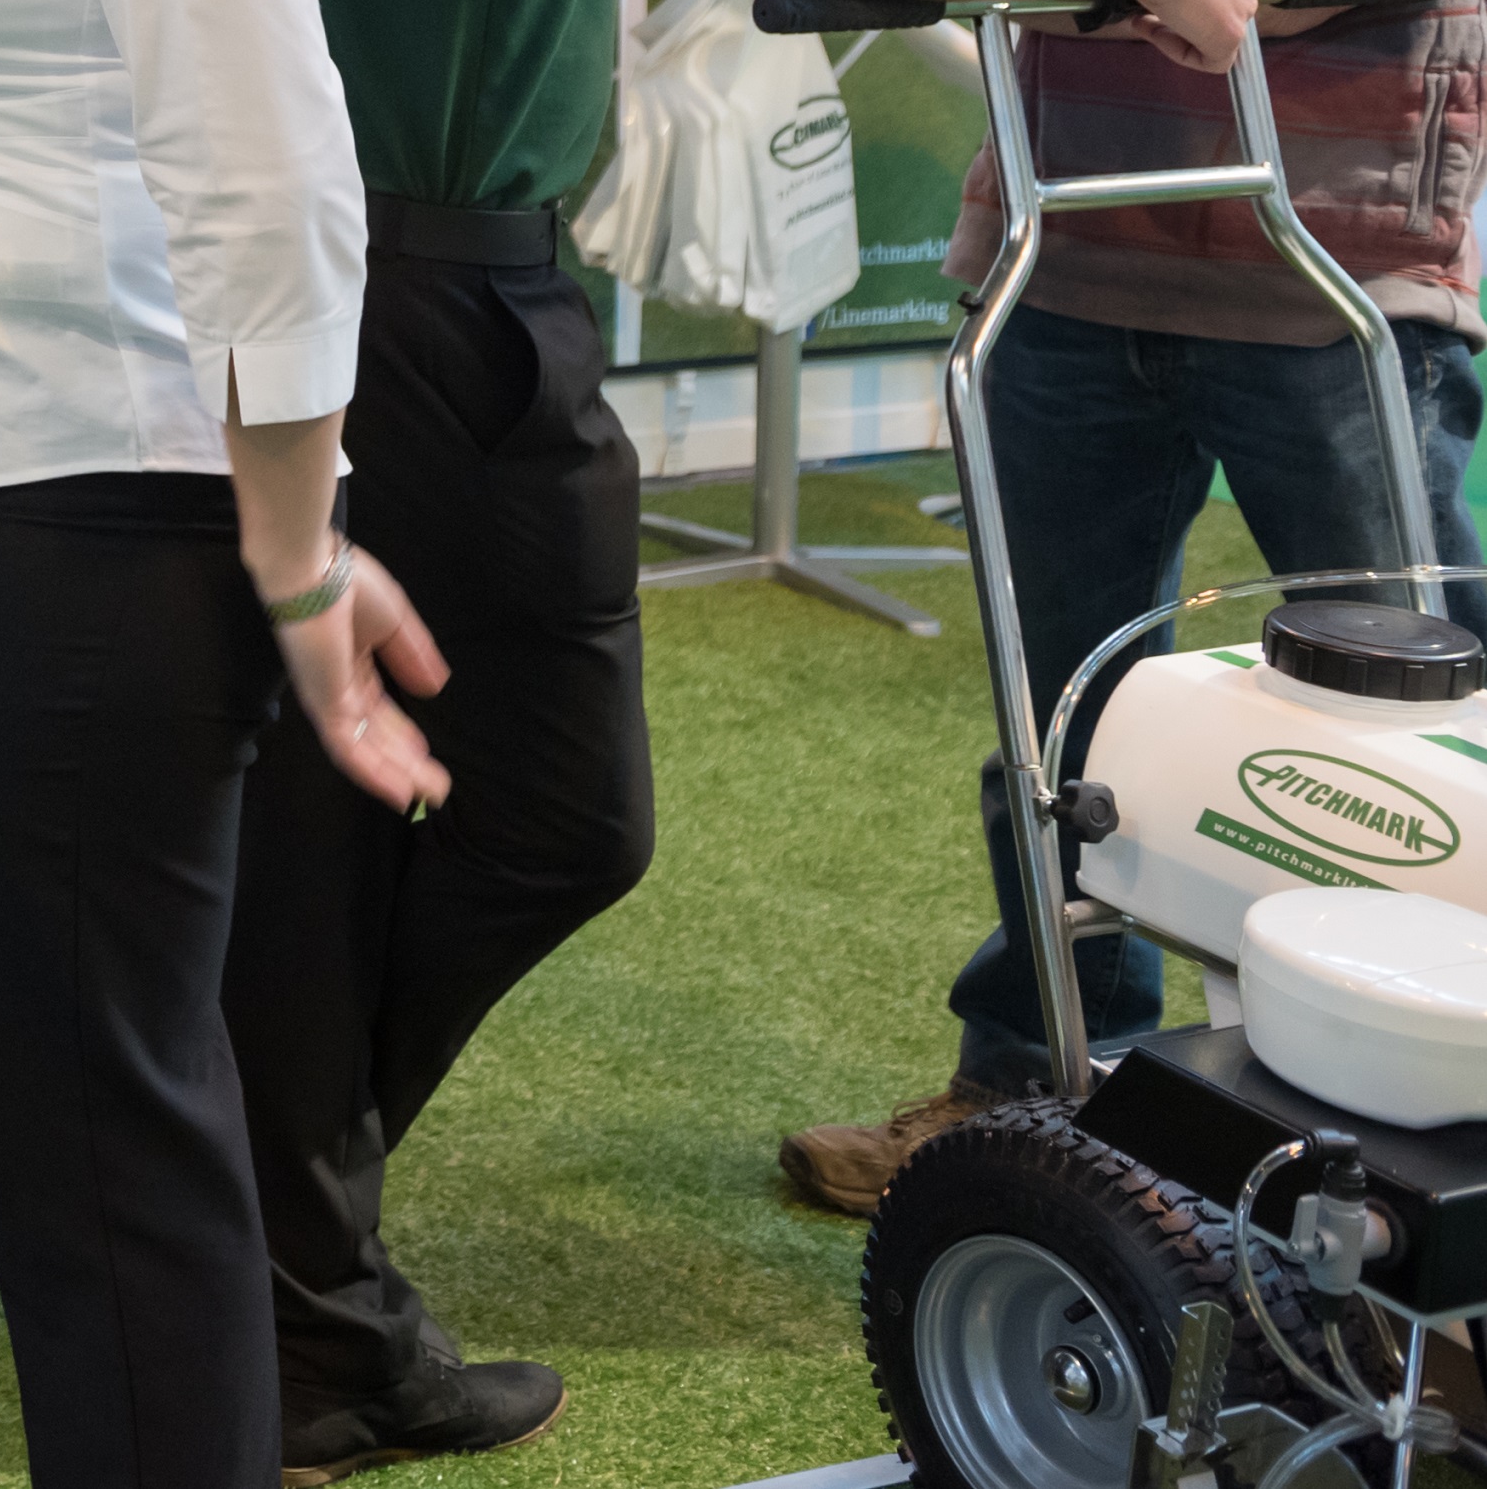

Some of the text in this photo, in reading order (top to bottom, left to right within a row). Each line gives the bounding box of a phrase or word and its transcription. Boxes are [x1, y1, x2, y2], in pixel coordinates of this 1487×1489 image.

[860, 238, 951, 266] tchmarkl
[821, 298, 950, 330] /Linemarking
[1256, 764, 1426, 854] PITCHMARK
[1214, 822, 1375, 888] www.pitchmarklt
